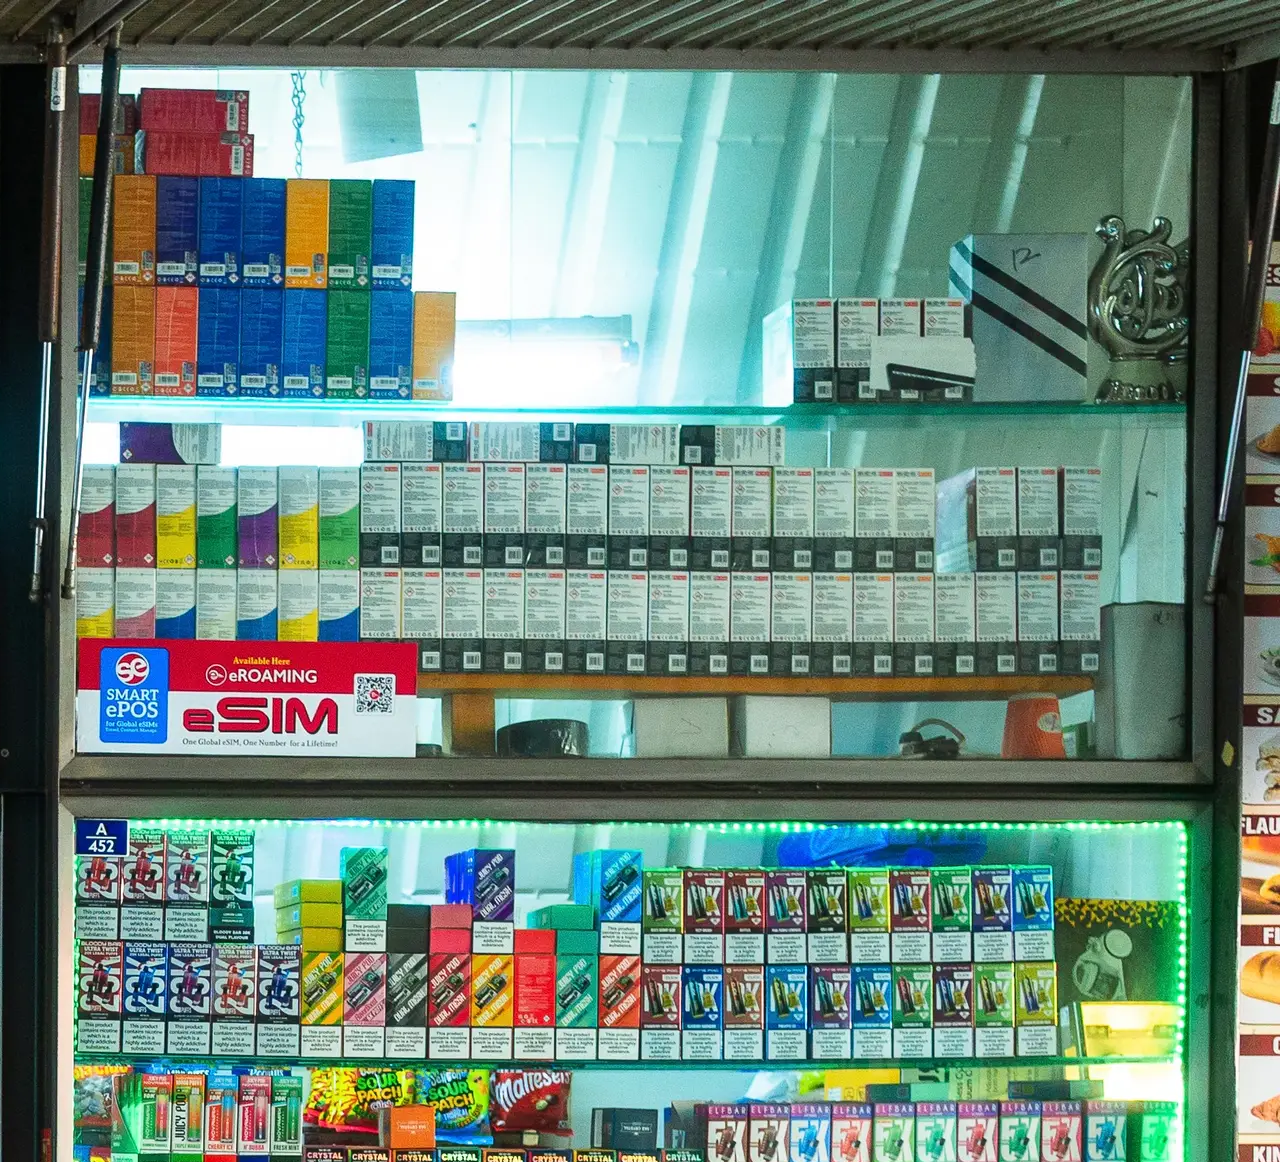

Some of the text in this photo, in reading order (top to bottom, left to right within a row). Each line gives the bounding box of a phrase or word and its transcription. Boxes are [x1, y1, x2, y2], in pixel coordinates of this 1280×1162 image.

[233, 657, 269, 665] Available
[229, 669, 317, 683] eROAMING
[107, 689, 158, 700] SMART
[106, 701, 158, 718] ePOS
[183, 697, 338, 734] eSIM
[96, 824, 107, 835] A
[89, 840, 114, 852] 452
[357, 1073, 398, 1090] SOUR
[357, 1087, 403, 1100] PATCH
[441, 1152, 478, 1162] CRYSTAL
